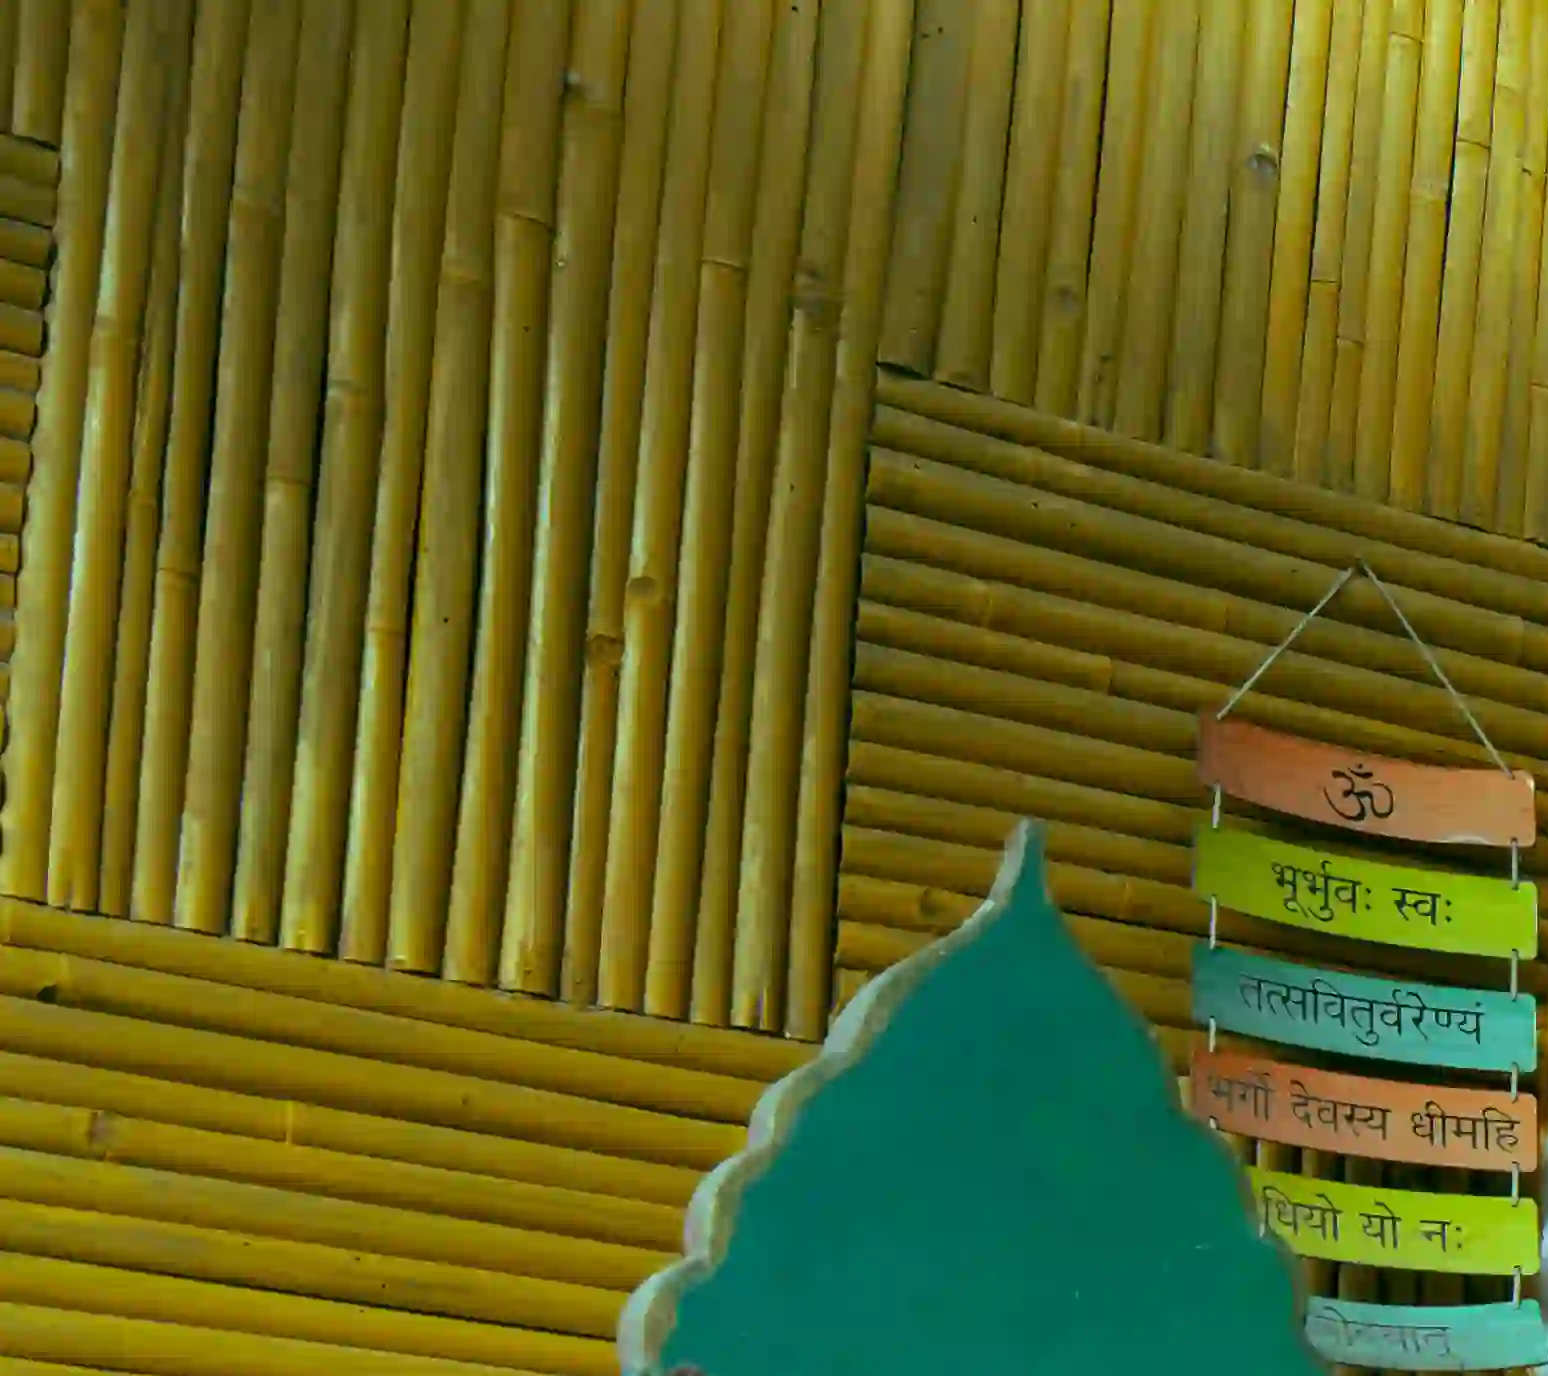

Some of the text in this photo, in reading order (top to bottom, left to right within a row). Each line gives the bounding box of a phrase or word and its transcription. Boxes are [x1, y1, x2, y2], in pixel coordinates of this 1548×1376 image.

[1391, 886, 1453, 926] स्वः
[1410, 1100, 1522, 1153] धीमहि
[1359, 1201, 1402, 1251] यो
